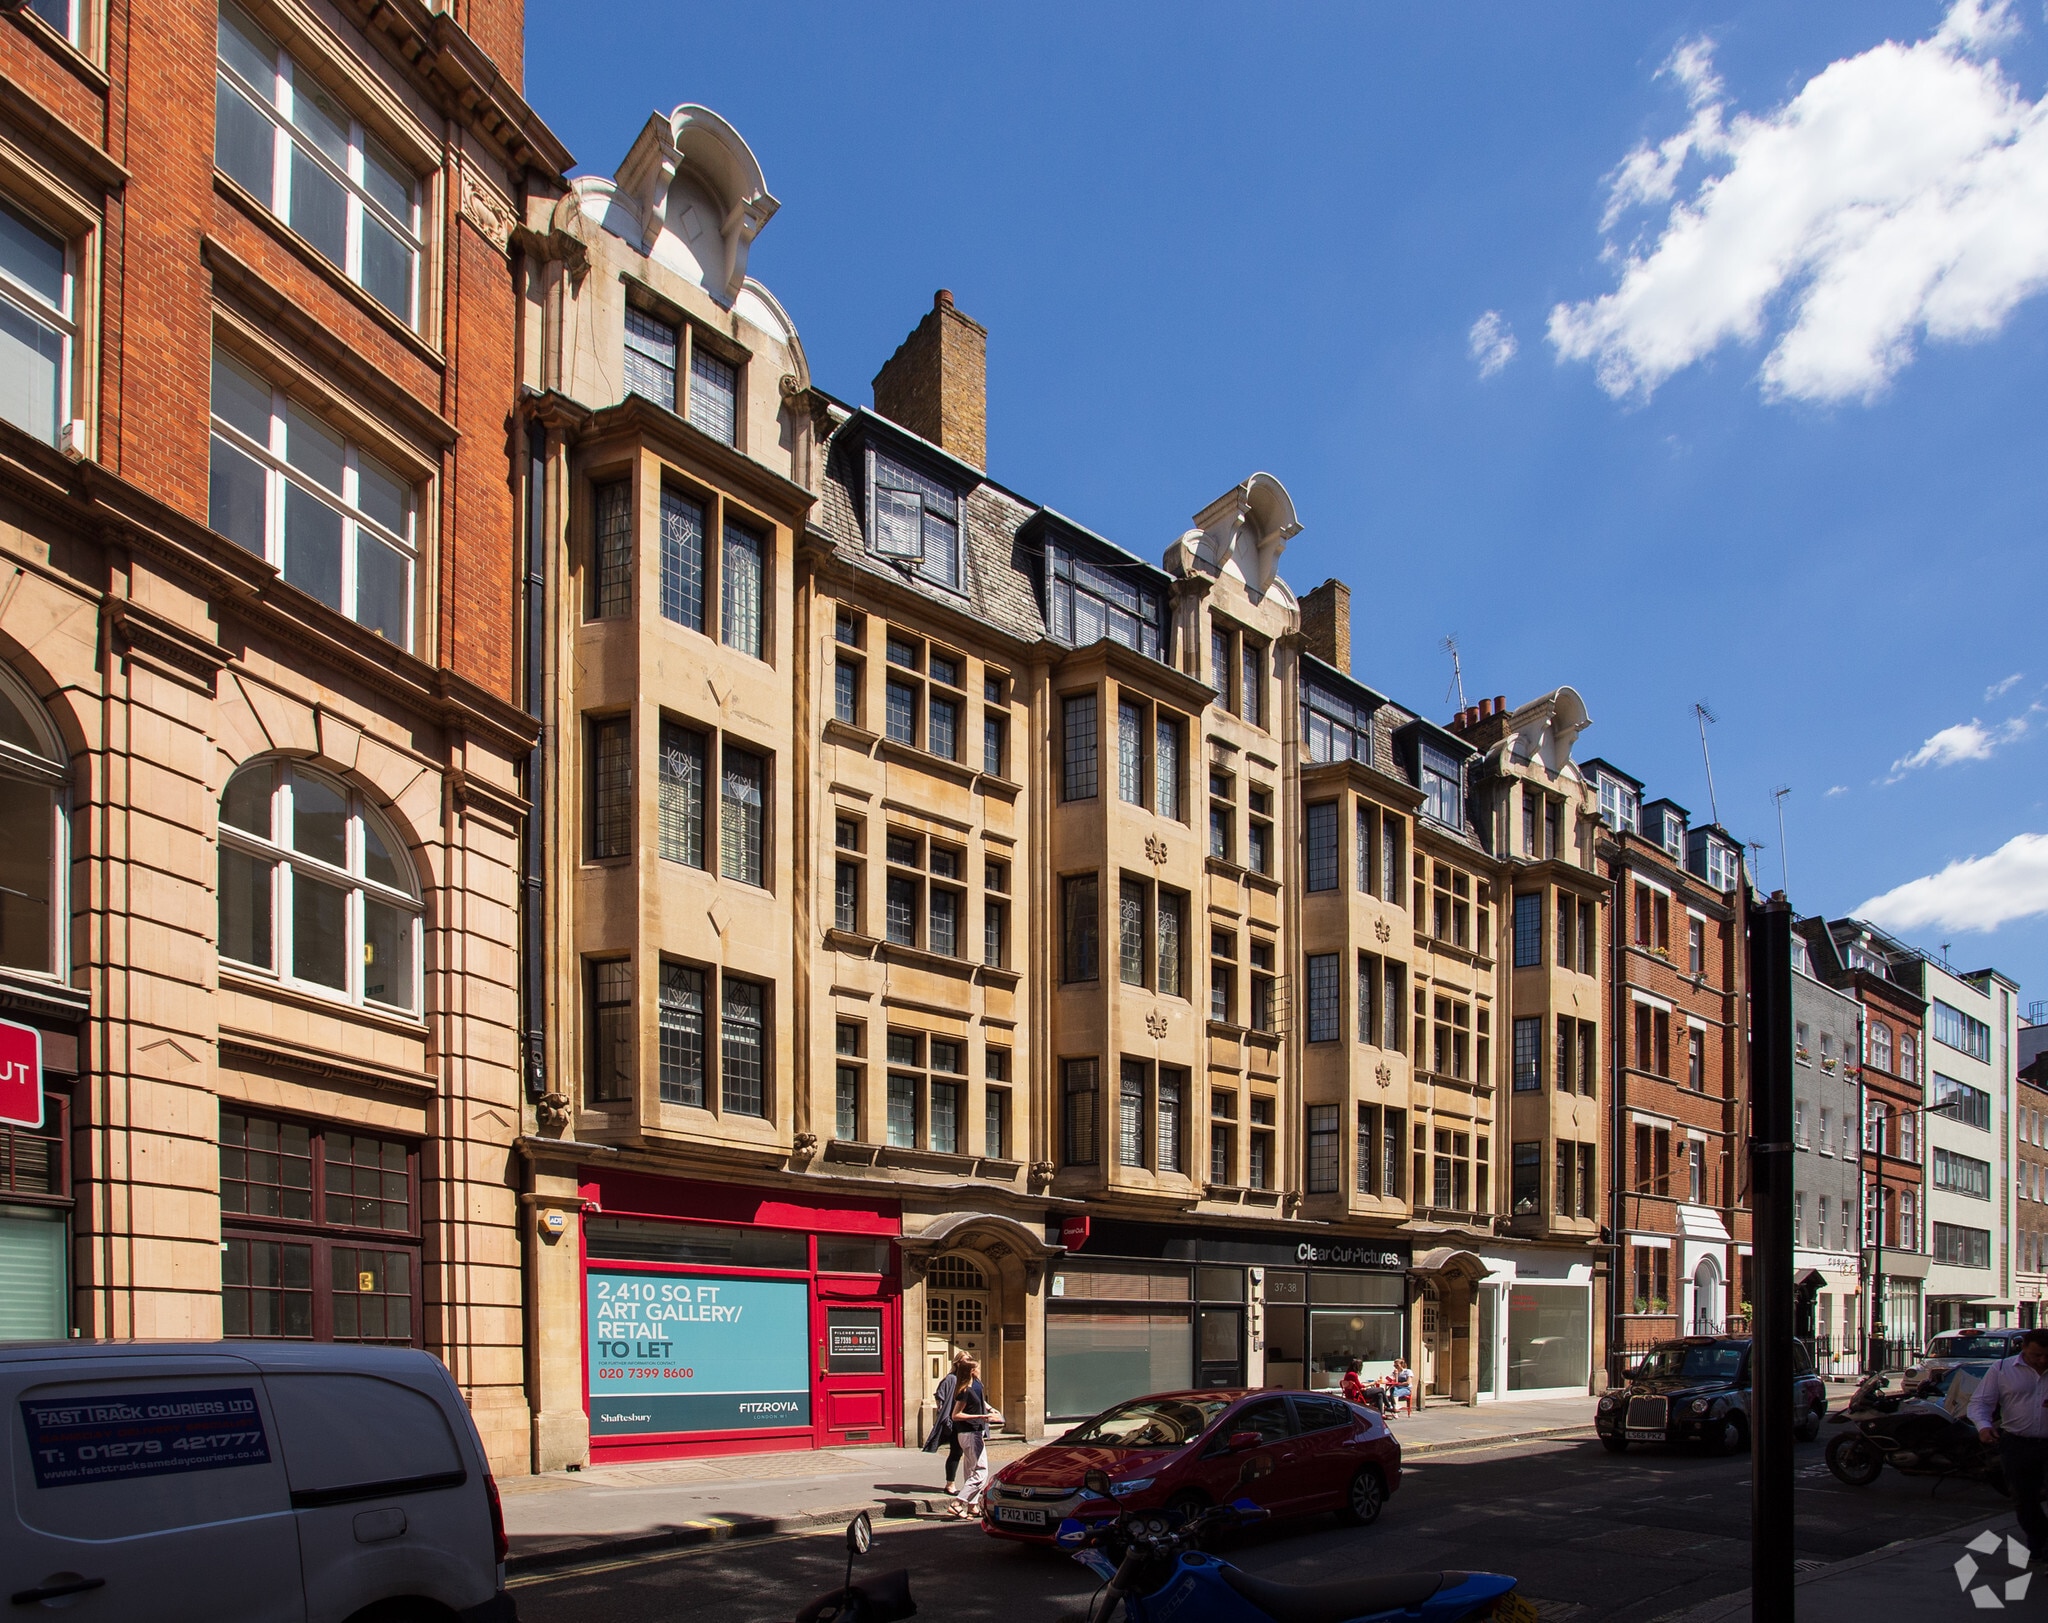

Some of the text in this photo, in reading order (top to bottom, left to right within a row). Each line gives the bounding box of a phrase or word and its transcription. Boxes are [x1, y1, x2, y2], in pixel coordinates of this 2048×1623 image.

[549, 1217, 562, 1225] ADT
[597, 1281, 720, 1303] 2,410 SQ FT
[597, 1302, 743, 1323] ART GALLERY/
[598, 1322, 669, 1340] RETAIL
[597, 1341, 673, 1359] TO LET
[599, 1368, 694, 1379] 020 7399 8600
[37, 1400, 254, 1426] FAST TRACK COURIERS LTD
[739, 1402, 799, 1413] FITZROVIA
[600, 1413, 652, 1423] Shaftesbury
[38, 1431, 261, 1464] T: 01279 421777
[43, 1449, 265, 1480] www.fasttracksamedaycouriers.co.uk
[1001, 1509, 1042, 1523] FX12 WDE
